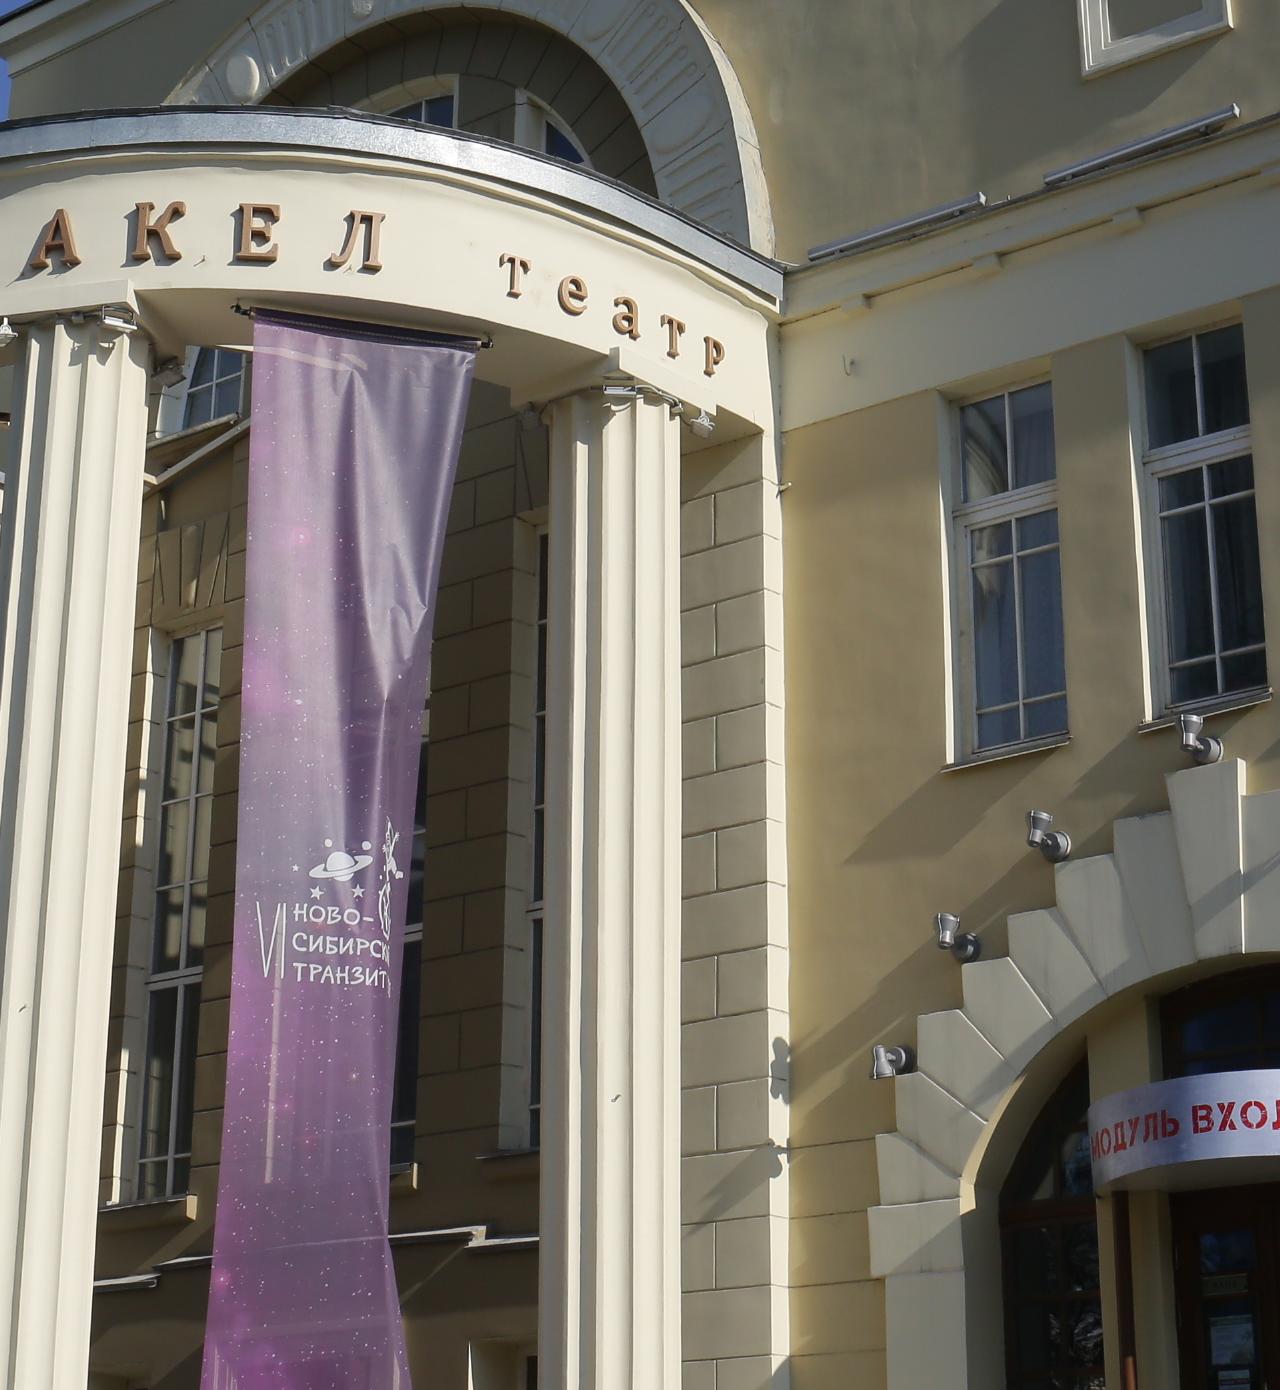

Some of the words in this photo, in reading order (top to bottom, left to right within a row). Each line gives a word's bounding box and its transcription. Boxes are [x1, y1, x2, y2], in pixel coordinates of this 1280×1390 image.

[293, 903, 374, 925] НОВО-
[293, 962, 387, 988] ТРАНЗИТ
[1090, 1108, 1180, 1160] МОДУЛЬ
